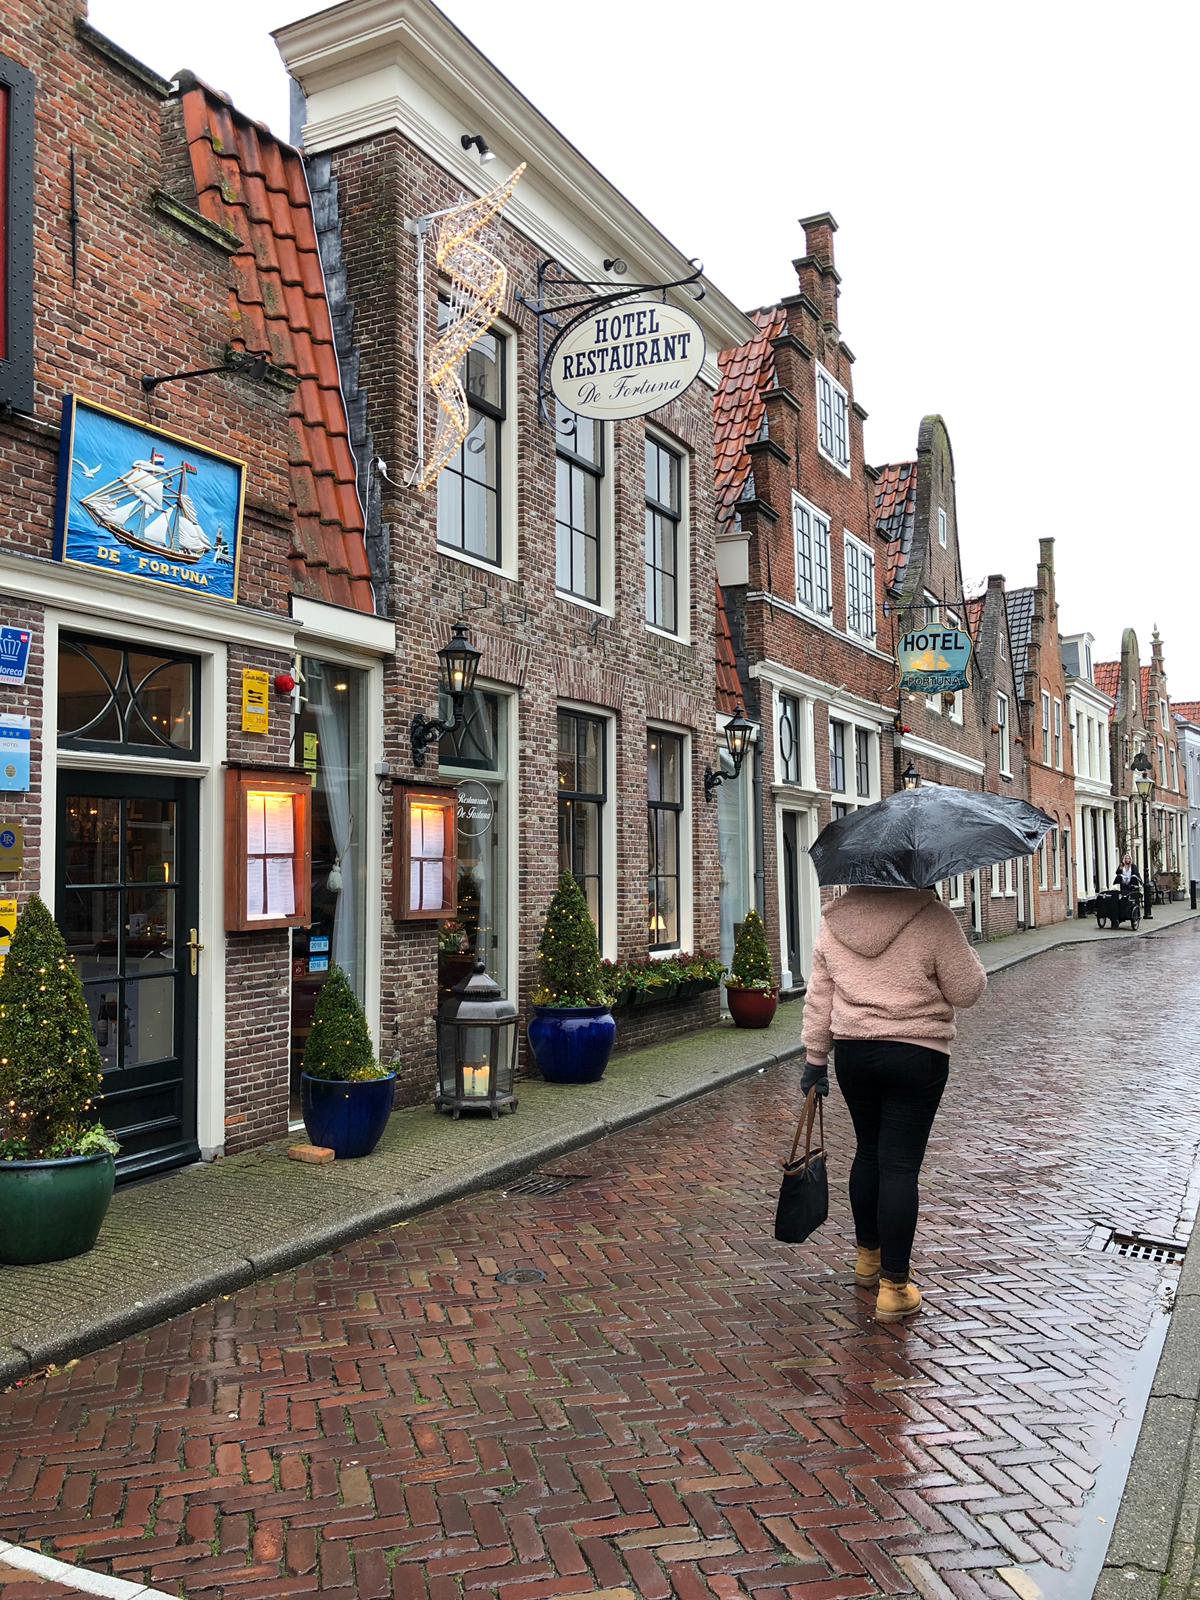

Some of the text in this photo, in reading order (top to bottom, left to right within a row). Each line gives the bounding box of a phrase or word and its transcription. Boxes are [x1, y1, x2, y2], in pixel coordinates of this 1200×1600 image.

[594, 309, 660, 344] HOTEL
[562, 333, 691, 380] RESTAURANT
[577, 373, 683, 406] De Fortuna
[97, 546, 120, 563] DE
[904, 633, 964, 652] HOTEL
